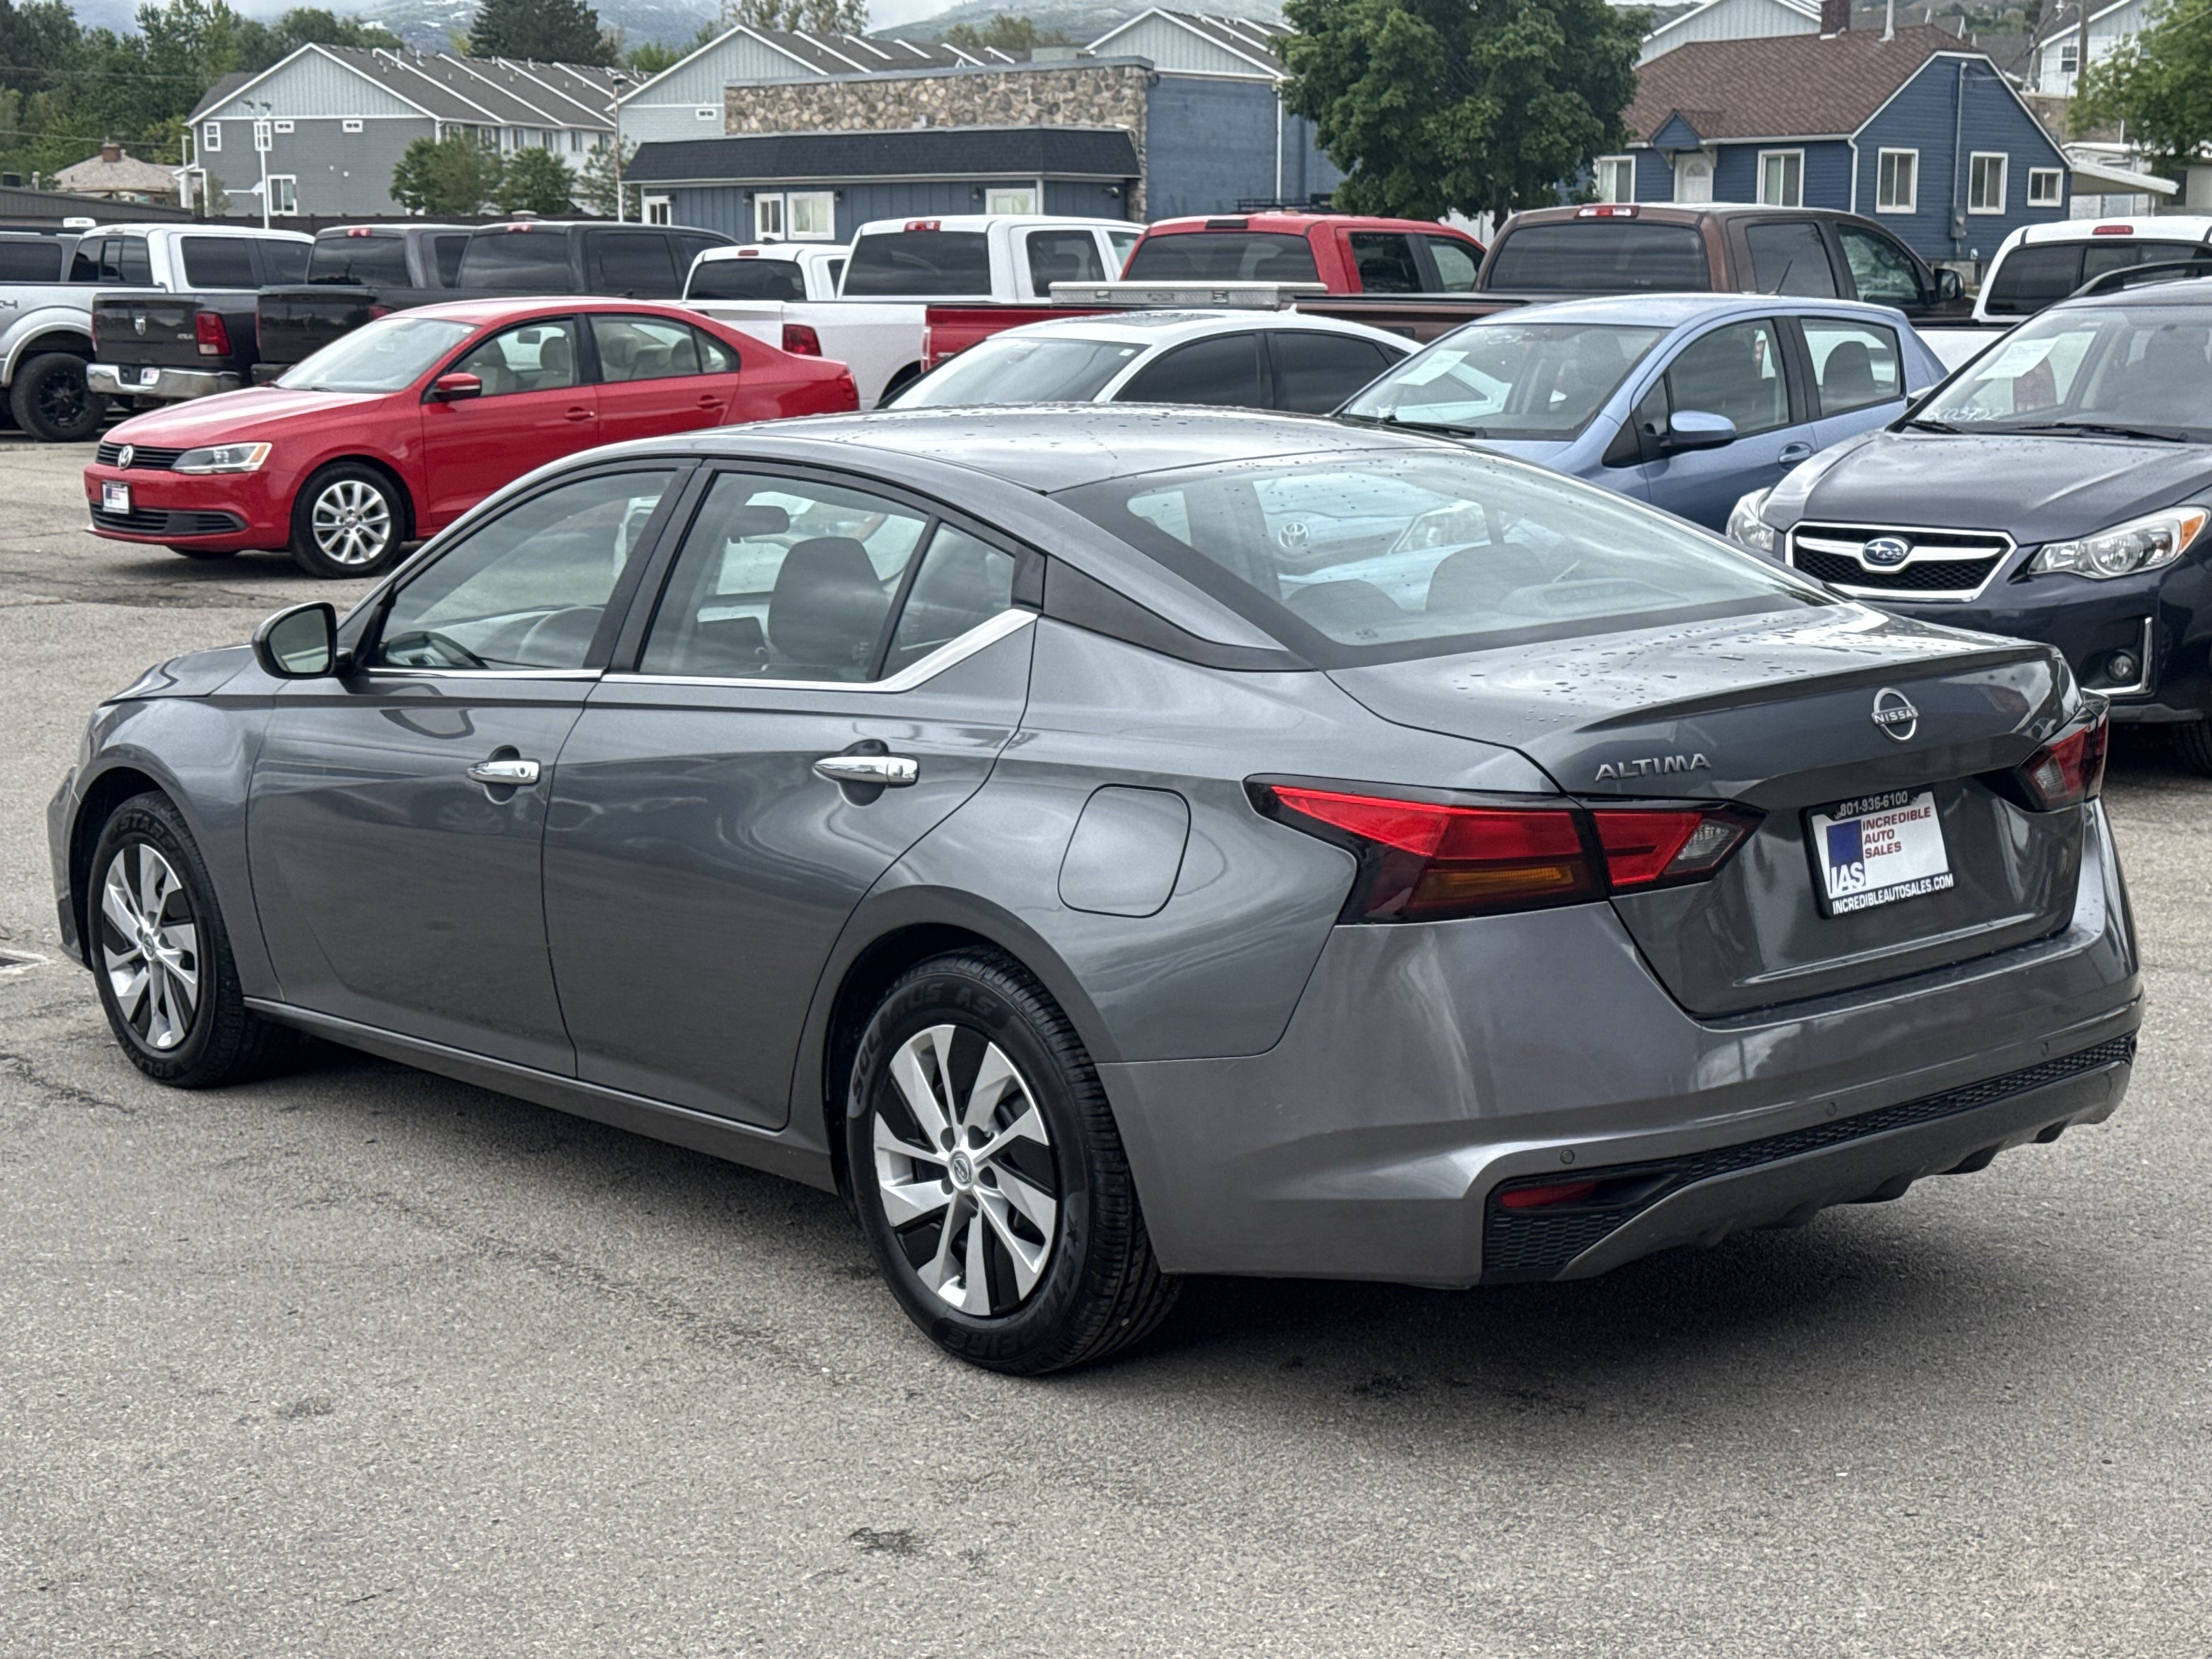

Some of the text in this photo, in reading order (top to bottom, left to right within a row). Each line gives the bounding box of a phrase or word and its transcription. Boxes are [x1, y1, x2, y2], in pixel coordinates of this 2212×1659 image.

[1874, 708, 1916, 724] NISSAN
[1595, 753, 1712, 781] ALTIMA
[1839, 790, 1909, 816] 801-936-6100
[1862, 806, 1932, 832] INCREDIBLE
[1864, 828, 1895, 845] AUTO
[1865, 840, 1902, 859] SALES
[1830, 861, 1865, 895] IAS
[1832, 873, 1954, 915] INCREDIBLEAUTOSALES.COM
